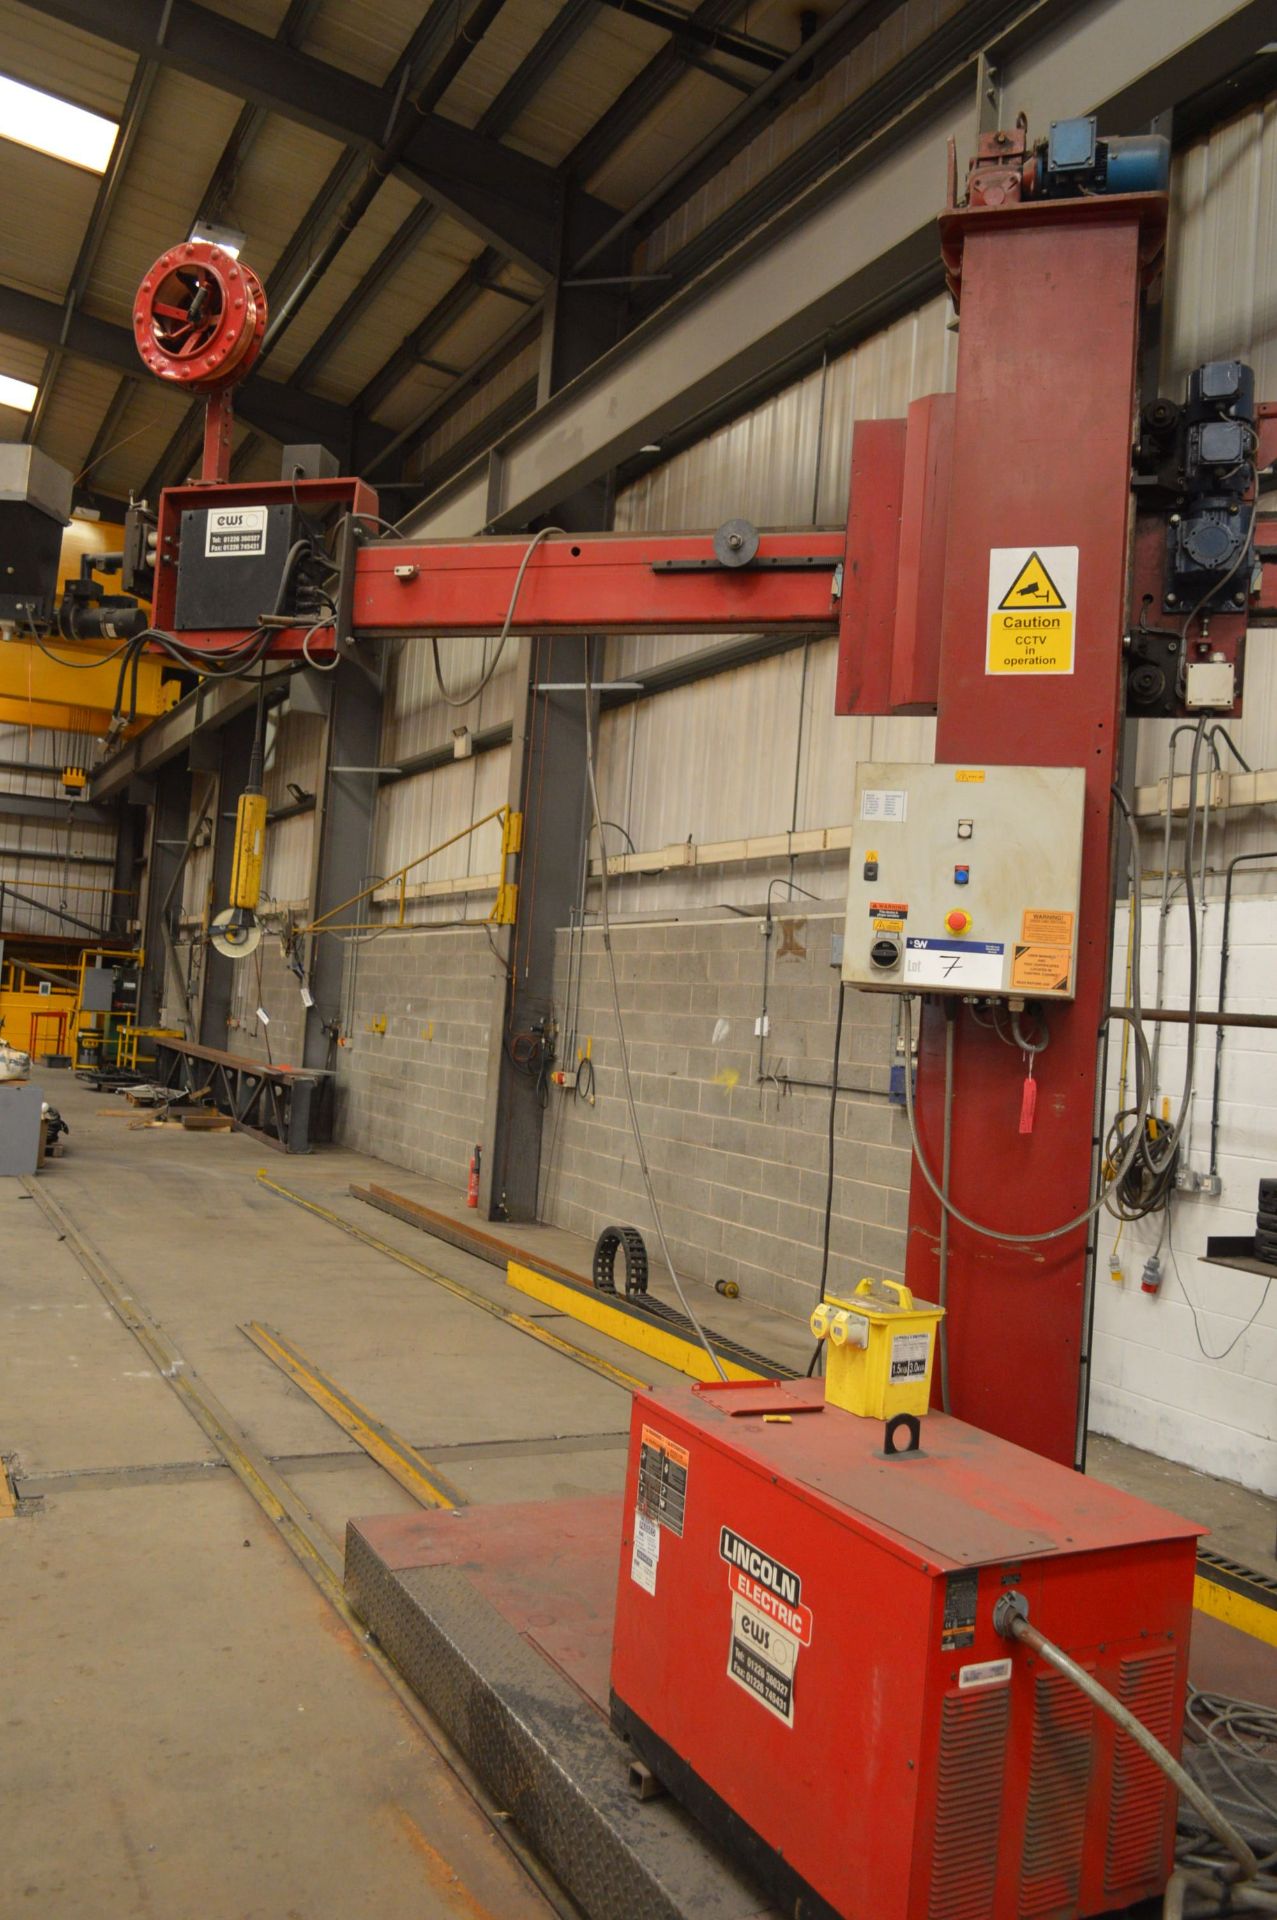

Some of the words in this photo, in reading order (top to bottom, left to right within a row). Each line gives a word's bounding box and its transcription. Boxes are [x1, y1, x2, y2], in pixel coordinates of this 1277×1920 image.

[1003, 616, 1060, 628] Caution
[1015, 636, 1047, 645] CCTV
[1025, 646, 1035, 655] in
[1003, 656, 1056, 667] operation
[907, 959, 921, 973] Lot
[939, 955, 963, 978] 7
[724, 1533, 796, 1603] LINCOLN
[737, 1573, 802, 1633] ELECTRIC
[735, 1647, 745, 1662] Tel:
[747, 1657, 765, 1678] 01226
[733, 1661, 745, 1678] Fax:
[746, 1671, 764, 1693] 01226
